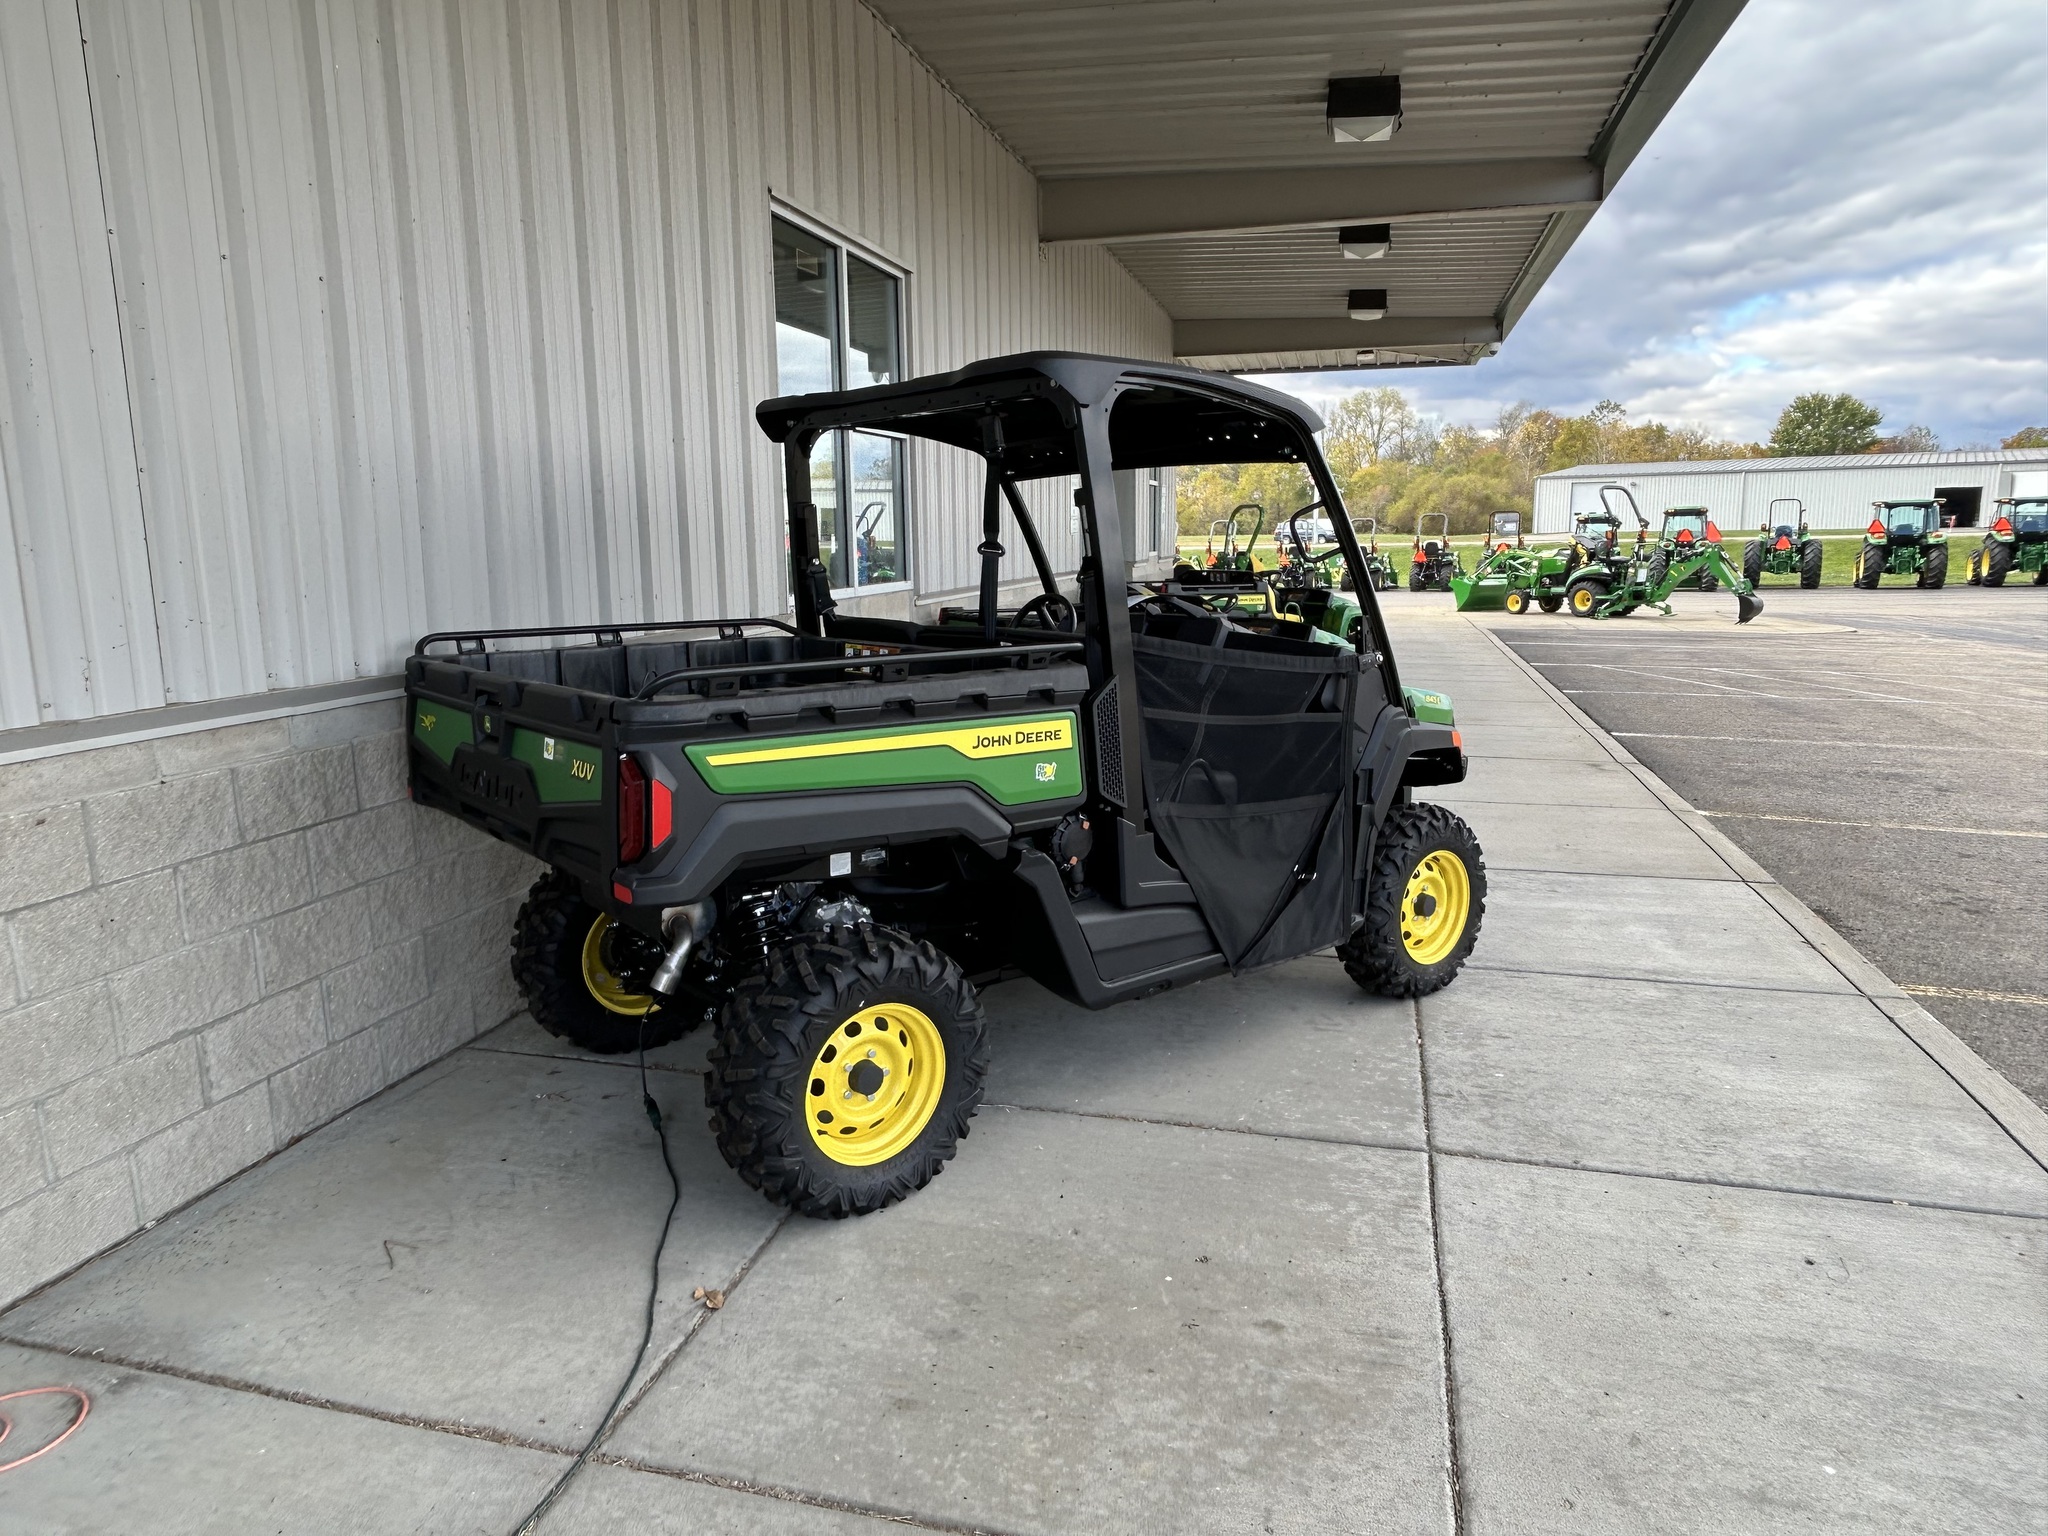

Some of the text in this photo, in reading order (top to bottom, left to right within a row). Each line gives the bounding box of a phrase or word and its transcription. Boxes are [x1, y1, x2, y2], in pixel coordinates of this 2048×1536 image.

[972, 729, 1062, 749] JOHN DEERE
[571, 759, 595, 781] XUV
